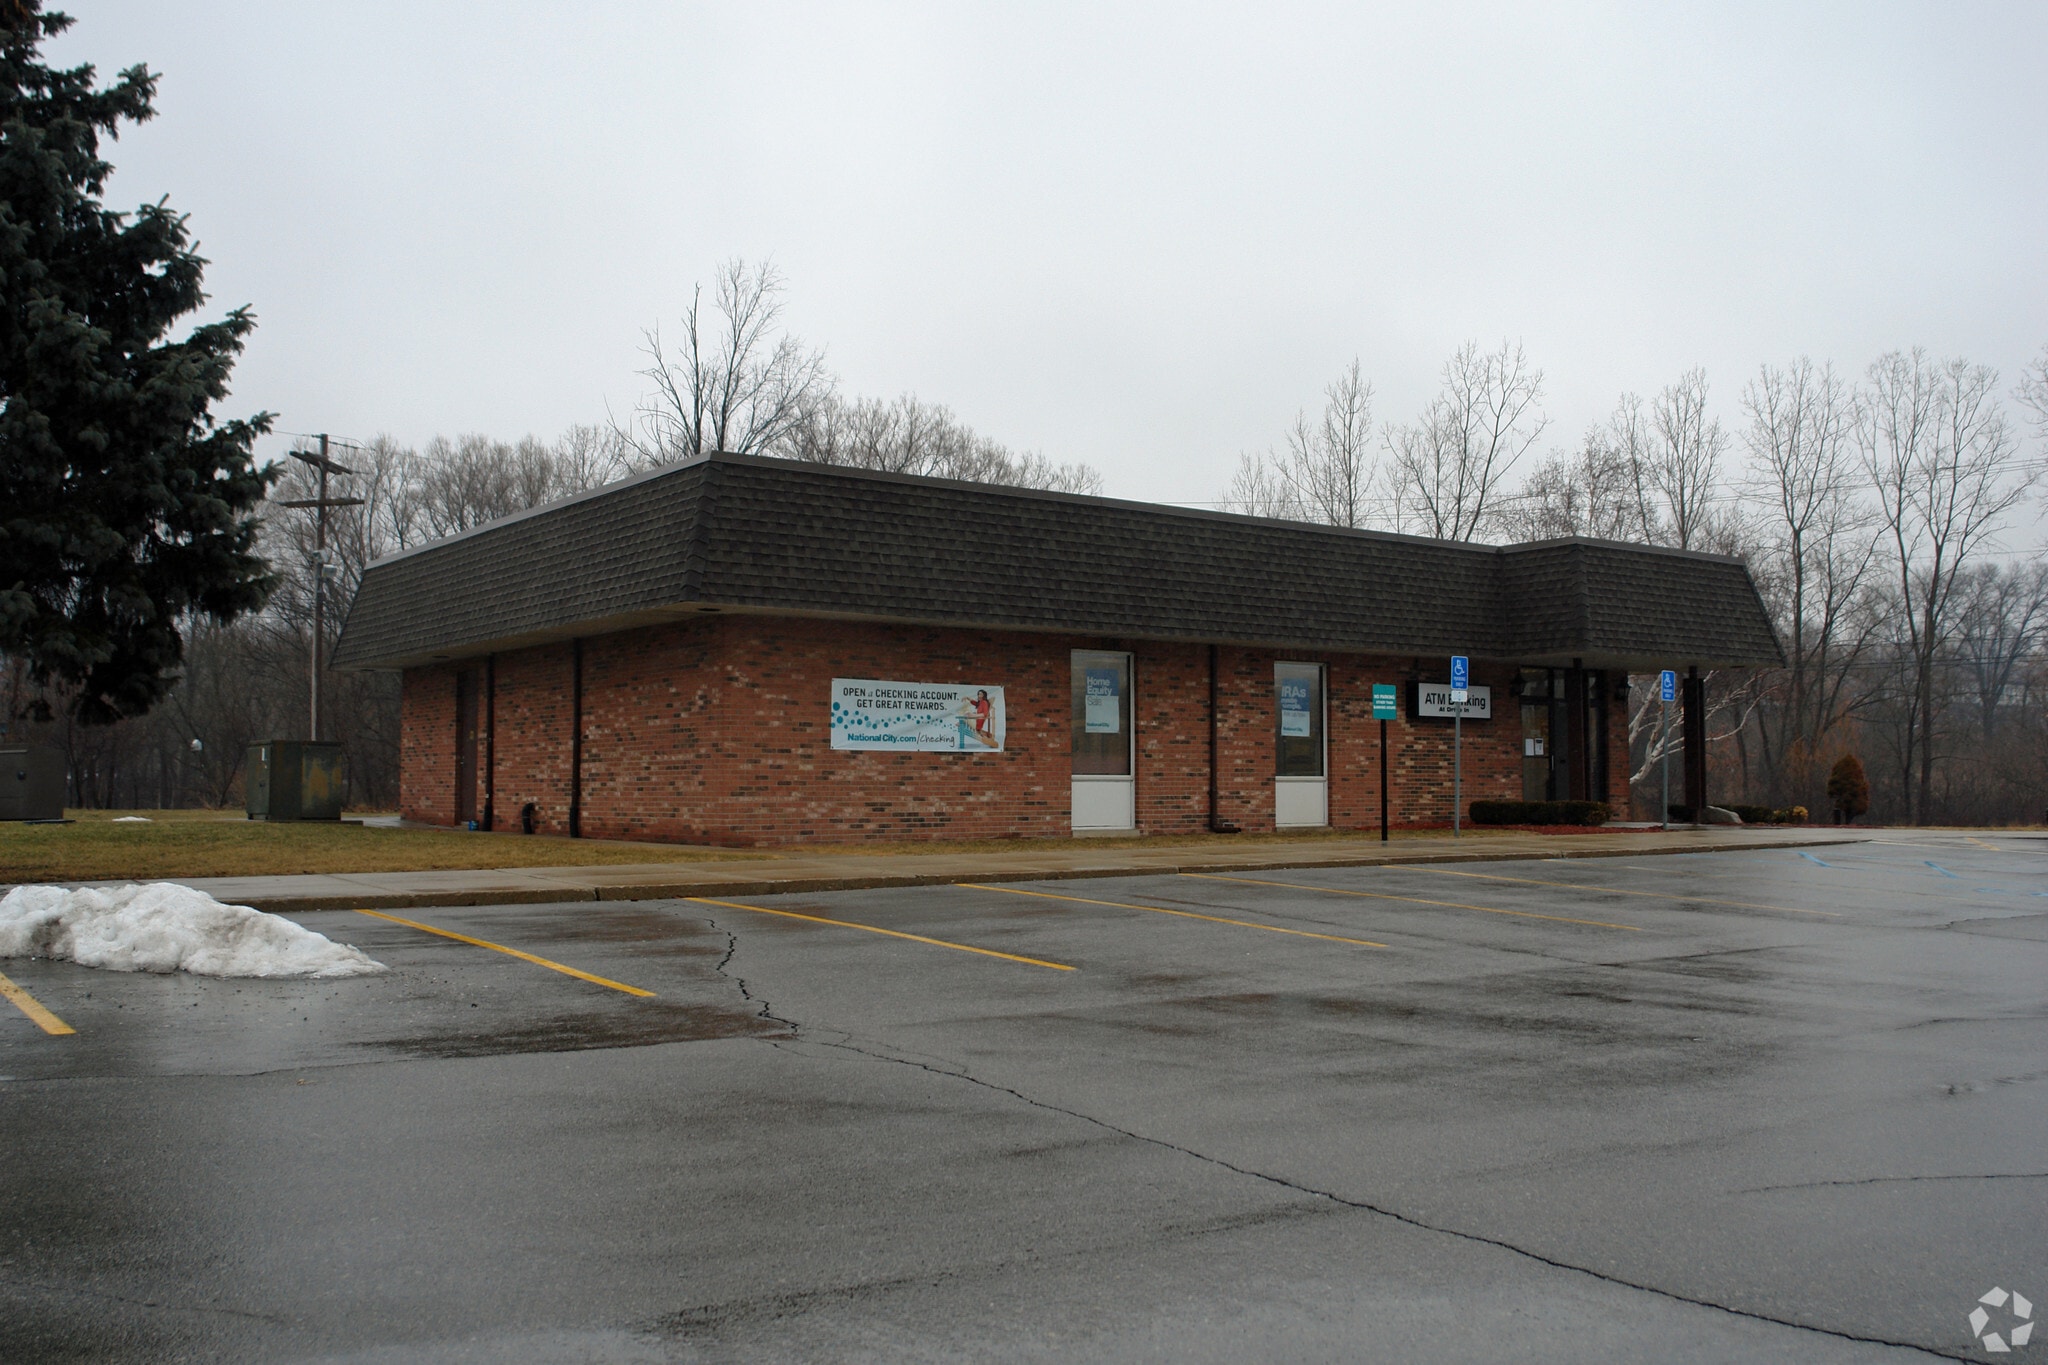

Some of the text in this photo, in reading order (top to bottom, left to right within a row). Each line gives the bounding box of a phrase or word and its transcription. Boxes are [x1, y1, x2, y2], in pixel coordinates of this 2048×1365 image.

[1086, 676, 1110, 686] Home
[843, 687, 866, 697] OPEN
[876, 688, 918, 699] CHECKING
[920, 690, 960, 700] ACCOUNT.
[1086, 686, 1112, 696] Equity
[1281, 686, 1306, 698] IRAs
[1425, 692, 1446, 704] ATM
[856, 699, 948, 710] GET GREAT REWARDS.
